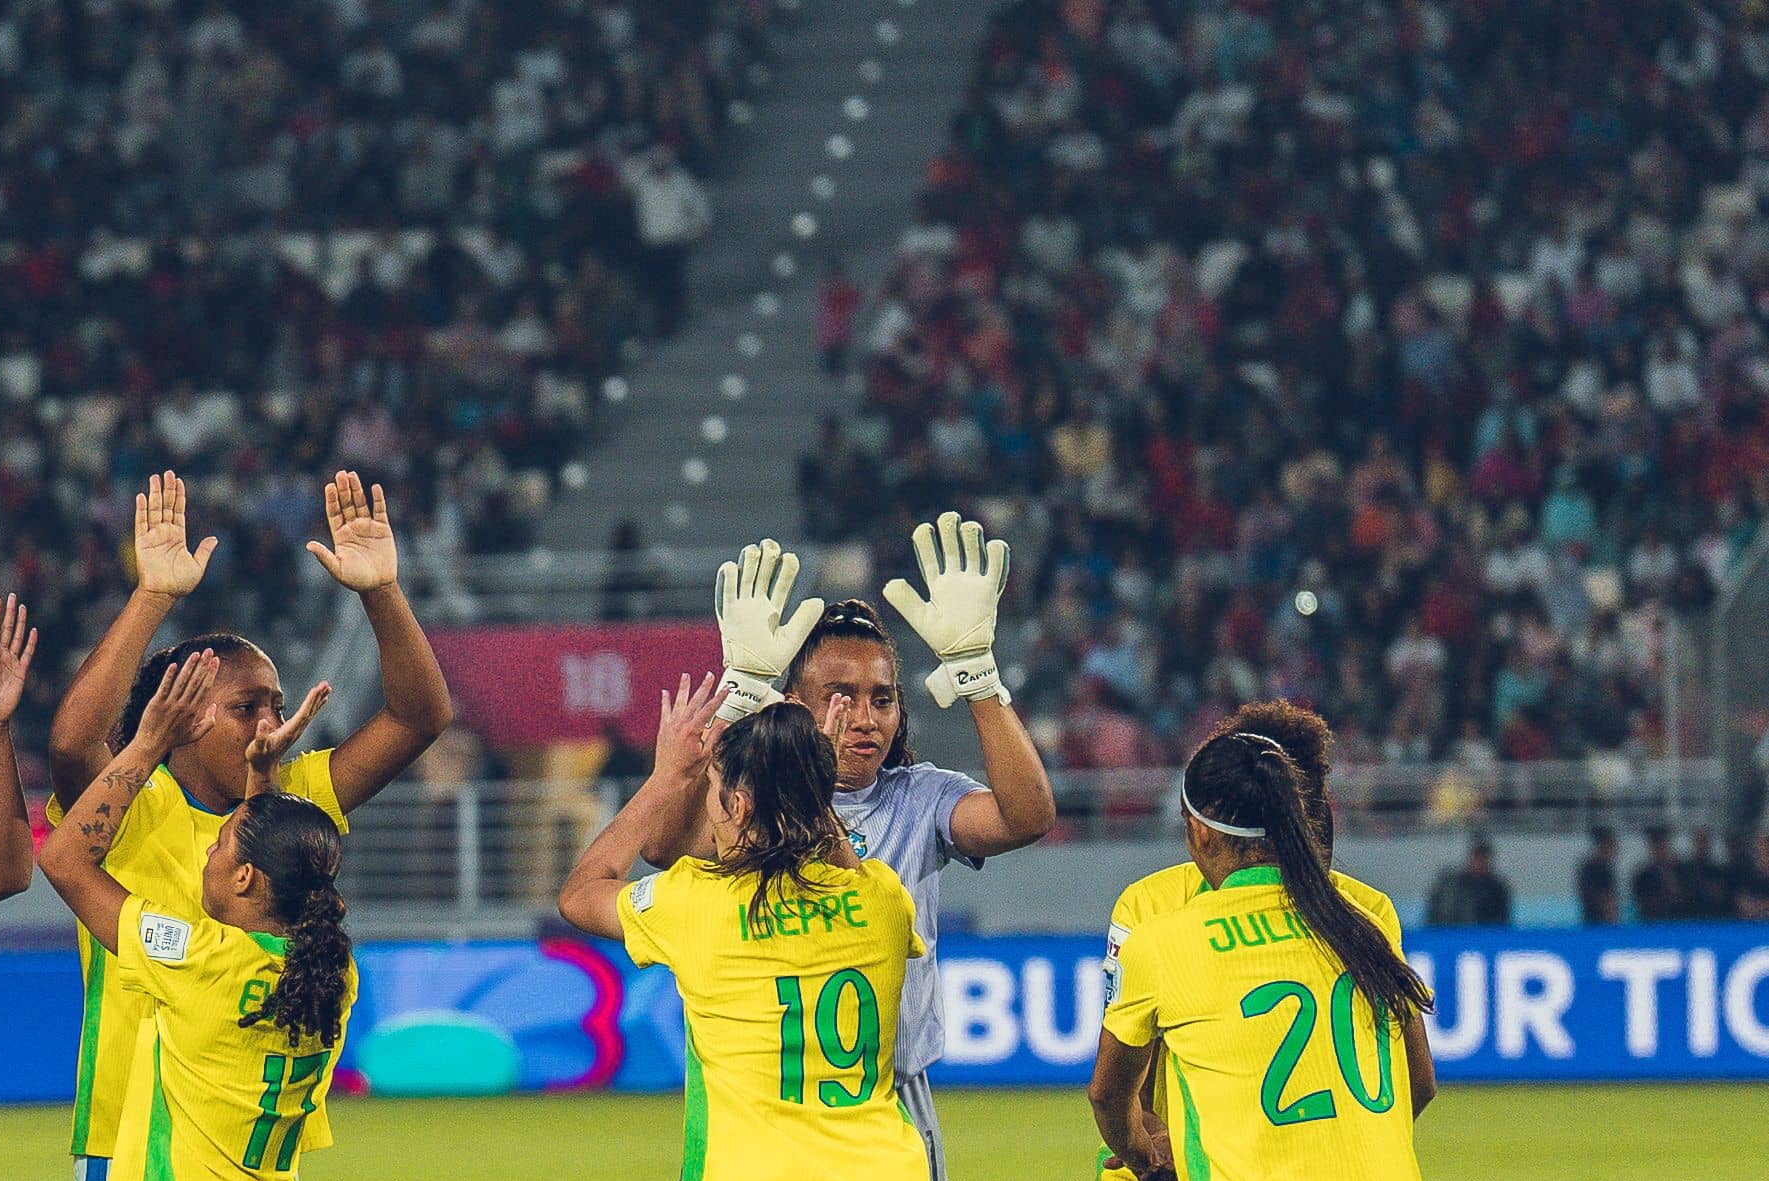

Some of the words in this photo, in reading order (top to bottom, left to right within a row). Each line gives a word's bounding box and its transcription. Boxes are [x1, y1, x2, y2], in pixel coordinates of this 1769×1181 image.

[738, 890, 868, 942] ISEPPE
[775, 967, 881, 1108] 19
[939, 956, 1107, 1065] BU
[1408, 948, 1575, 1061] UR
[1240, 970, 1395, 1127] 20
[242, 1049, 332, 1172] 17
